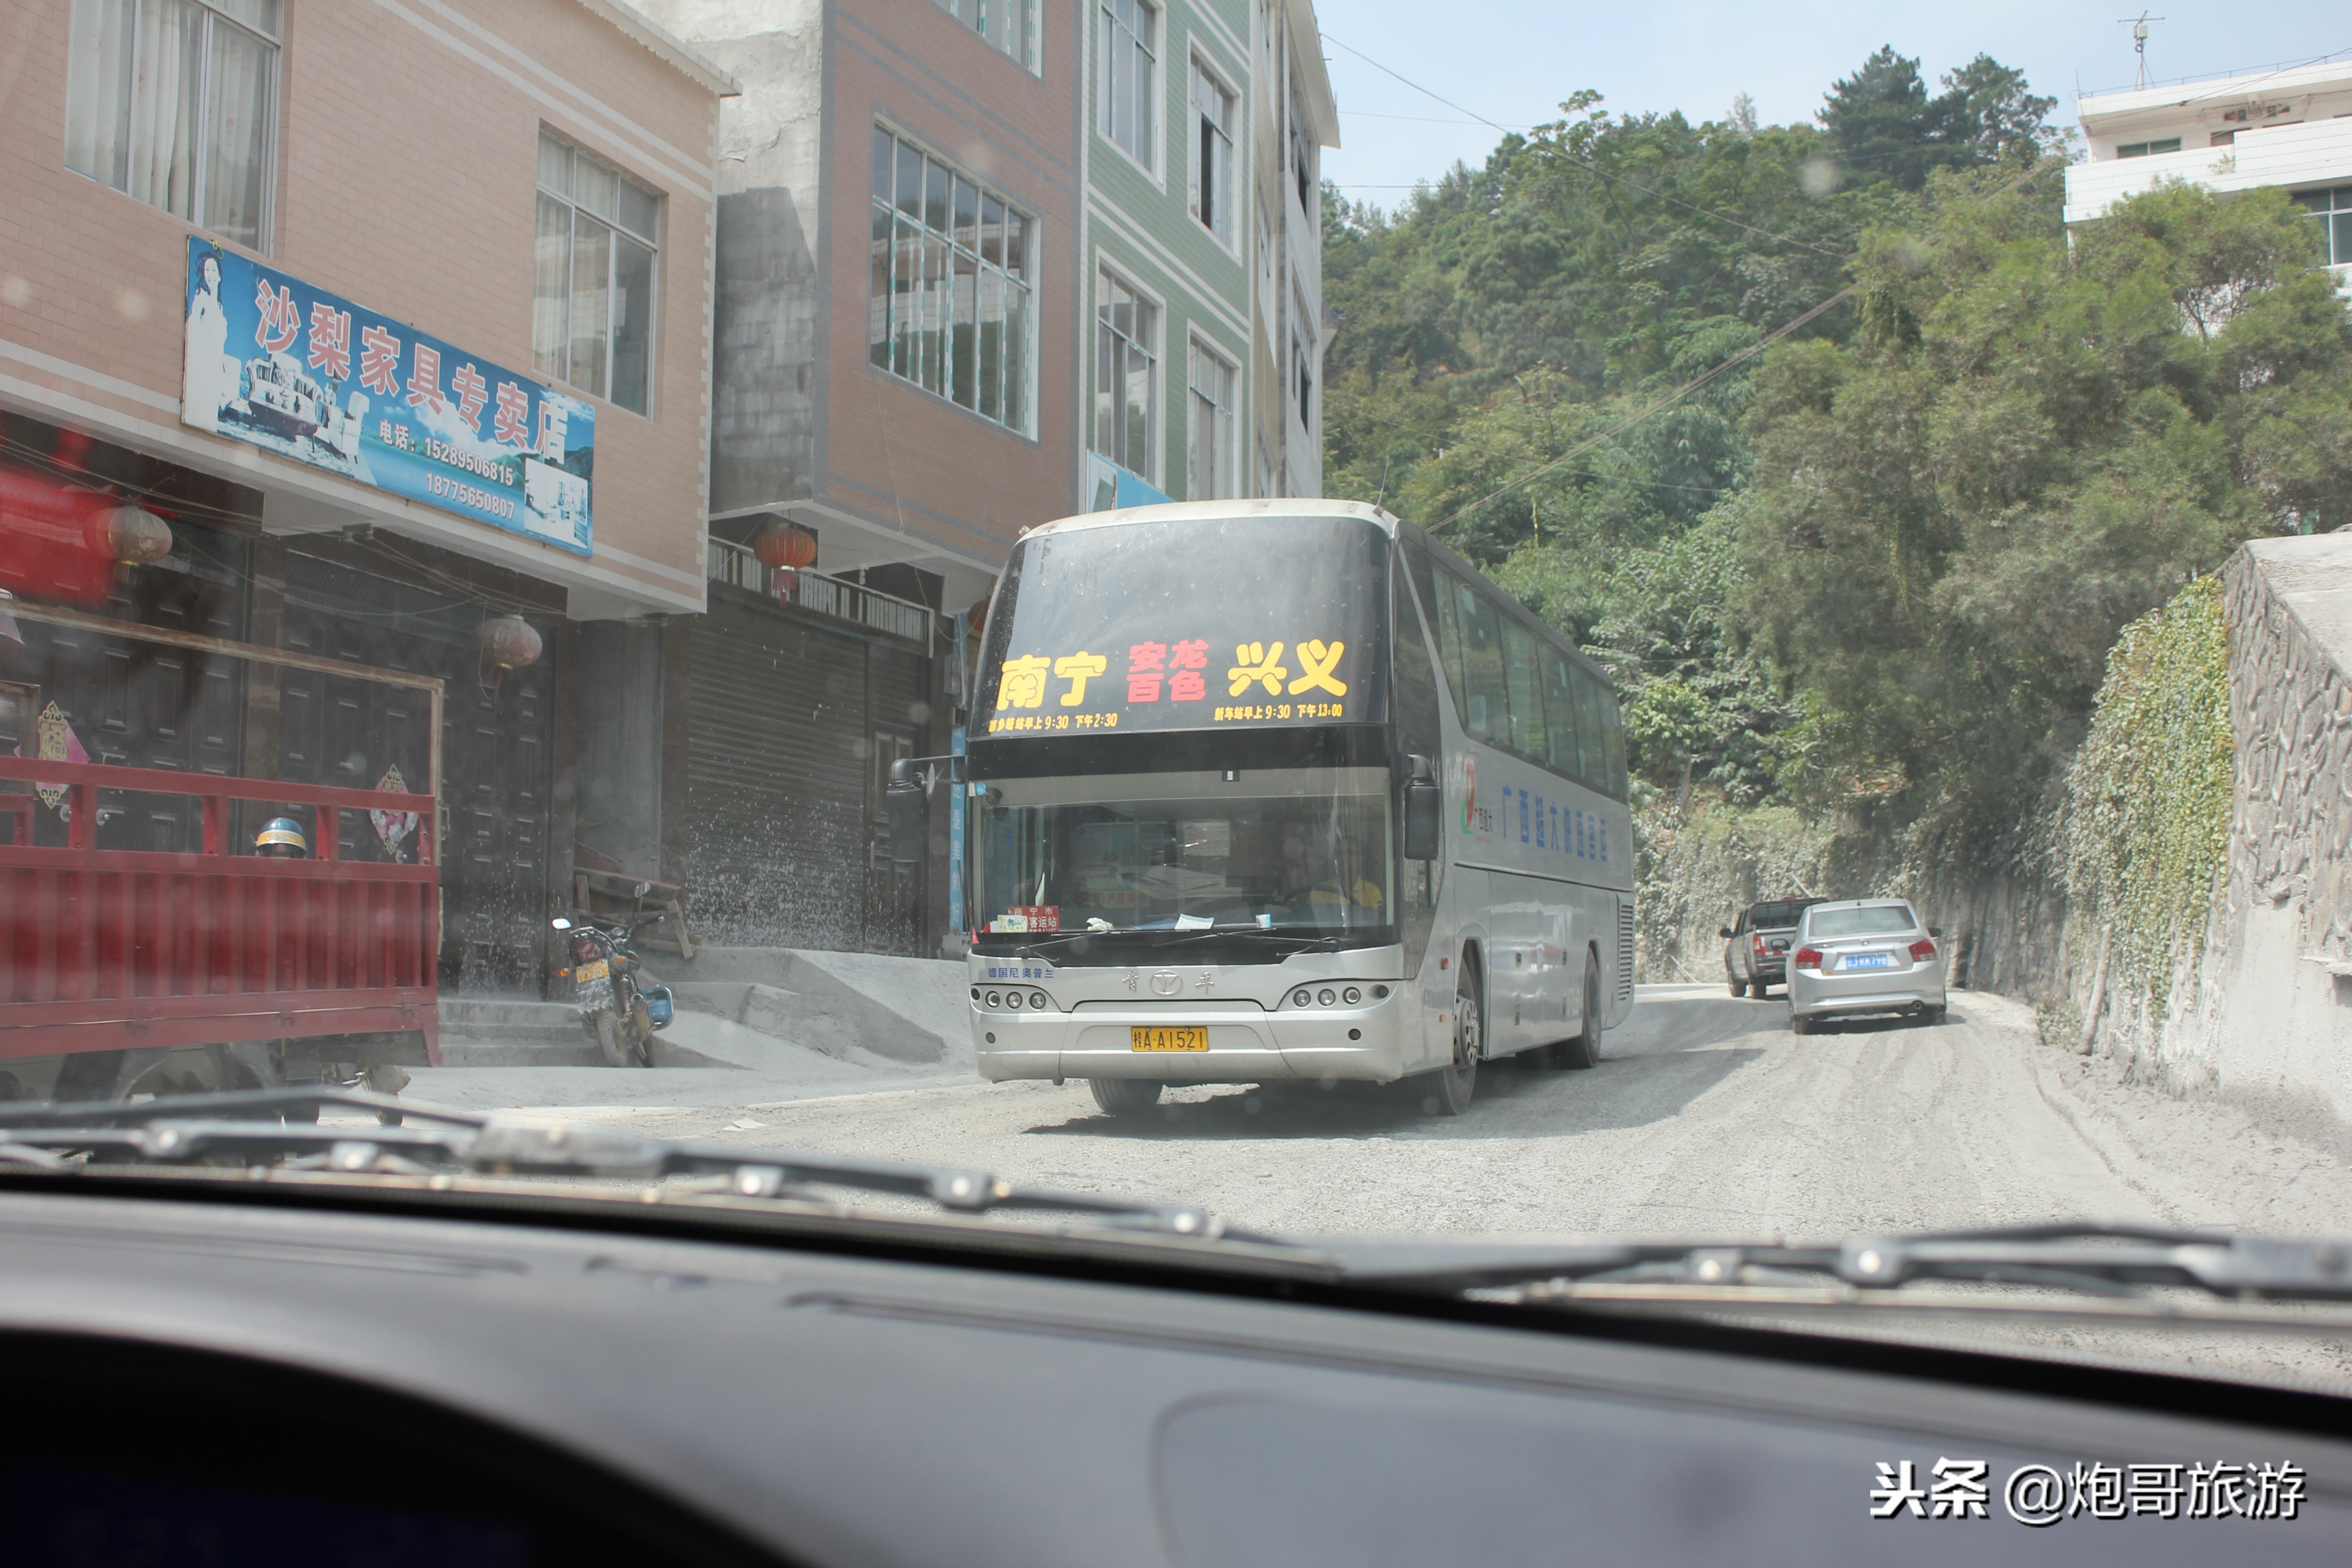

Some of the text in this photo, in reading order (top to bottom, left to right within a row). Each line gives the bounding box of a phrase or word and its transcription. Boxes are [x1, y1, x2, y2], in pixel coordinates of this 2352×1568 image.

[255, 279, 568, 465] 沙梨家具专卖店
[427, 473, 515, 520] 18775650807
[1128, 639, 1209, 673] 安龙
[1228, 639, 1348, 697] 兴义
[996, 651, 1107, 711] 南宁
[1127, 670, 1207, 703] 百色
[1075, 713, 1118, 728] 下午2:30
[1297, 703, 1342, 718] 下午13:00
[1029, 916, 1056, 929] 客运站
[988, 968, 1054, 978] 德国尼奥普兰
